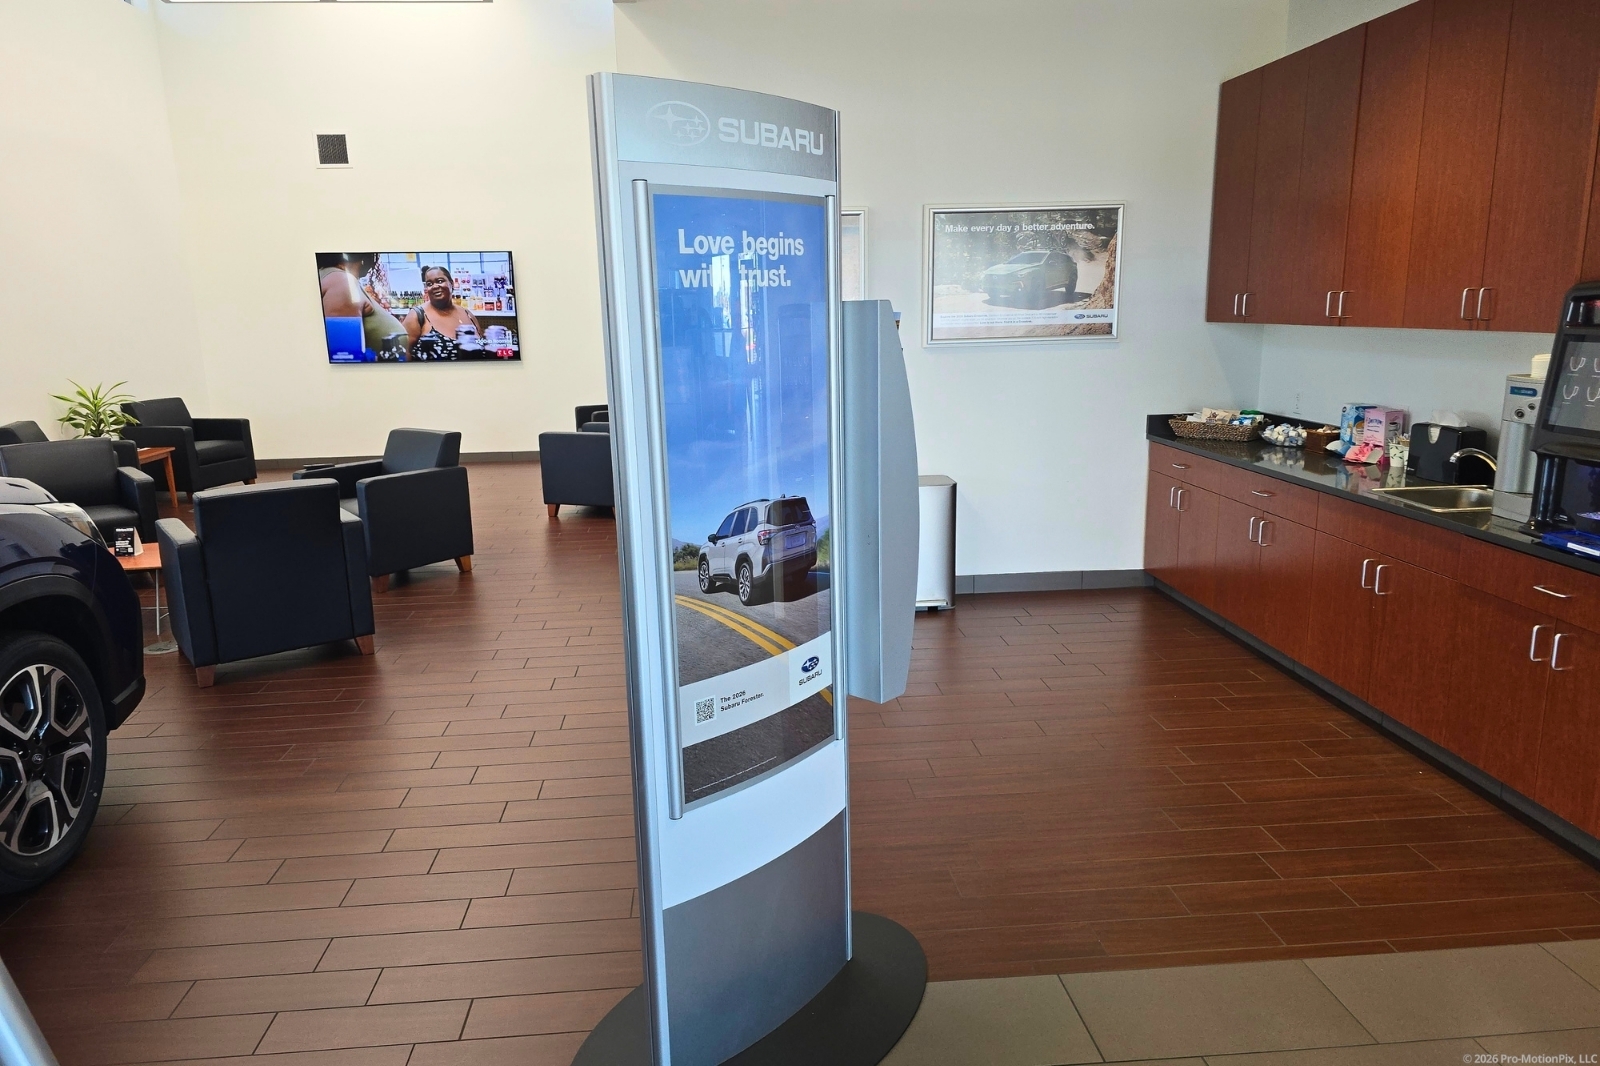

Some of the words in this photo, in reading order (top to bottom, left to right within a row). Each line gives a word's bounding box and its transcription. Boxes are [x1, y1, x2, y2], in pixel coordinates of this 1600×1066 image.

[718, 117, 824, 155] SUBARU
[945, 224, 969, 233] Make
[970, 223, 994, 234] every
[996, 223, 1012, 234] day
[1022, 222, 1049, 232] better
[1050, 222, 1096, 232] adventure.
[677, 228, 735, 254] Love
[742, 230, 804, 260] begins
[679, 262, 727, 288] wit
[739, 262, 791, 288] trust.
[799, 670, 822, 686] SUBARU
[720, 700, 741, 712] Subaru
[742, 692, 764, 704] Forester.
[732, 690, 746, 700] 2026
